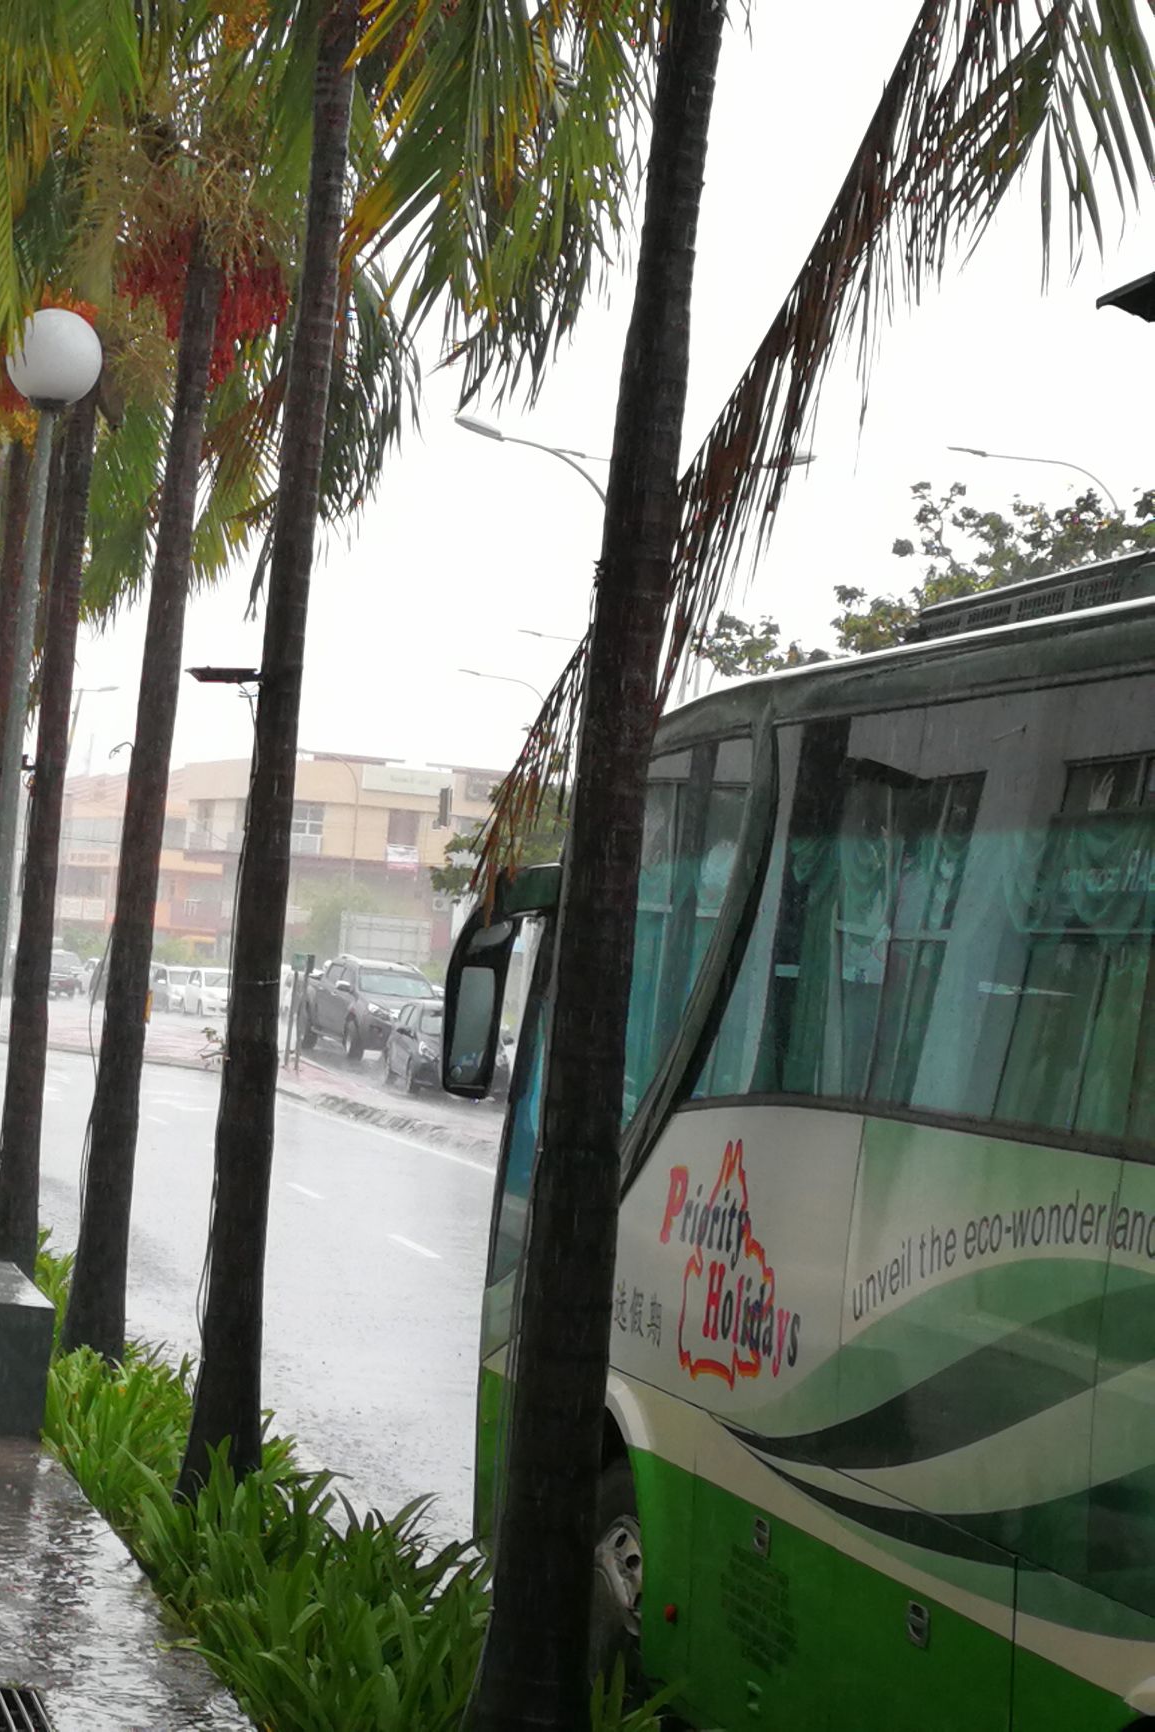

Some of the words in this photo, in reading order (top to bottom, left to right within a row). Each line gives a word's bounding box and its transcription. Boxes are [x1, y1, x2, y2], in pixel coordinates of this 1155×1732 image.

[659, 1165, 750, 1271] Priority
[702, 1260, 801, 1378] Holidays
[851, 1237, 911, 1321] unveil
[919, 1224, 957, 1279] the
